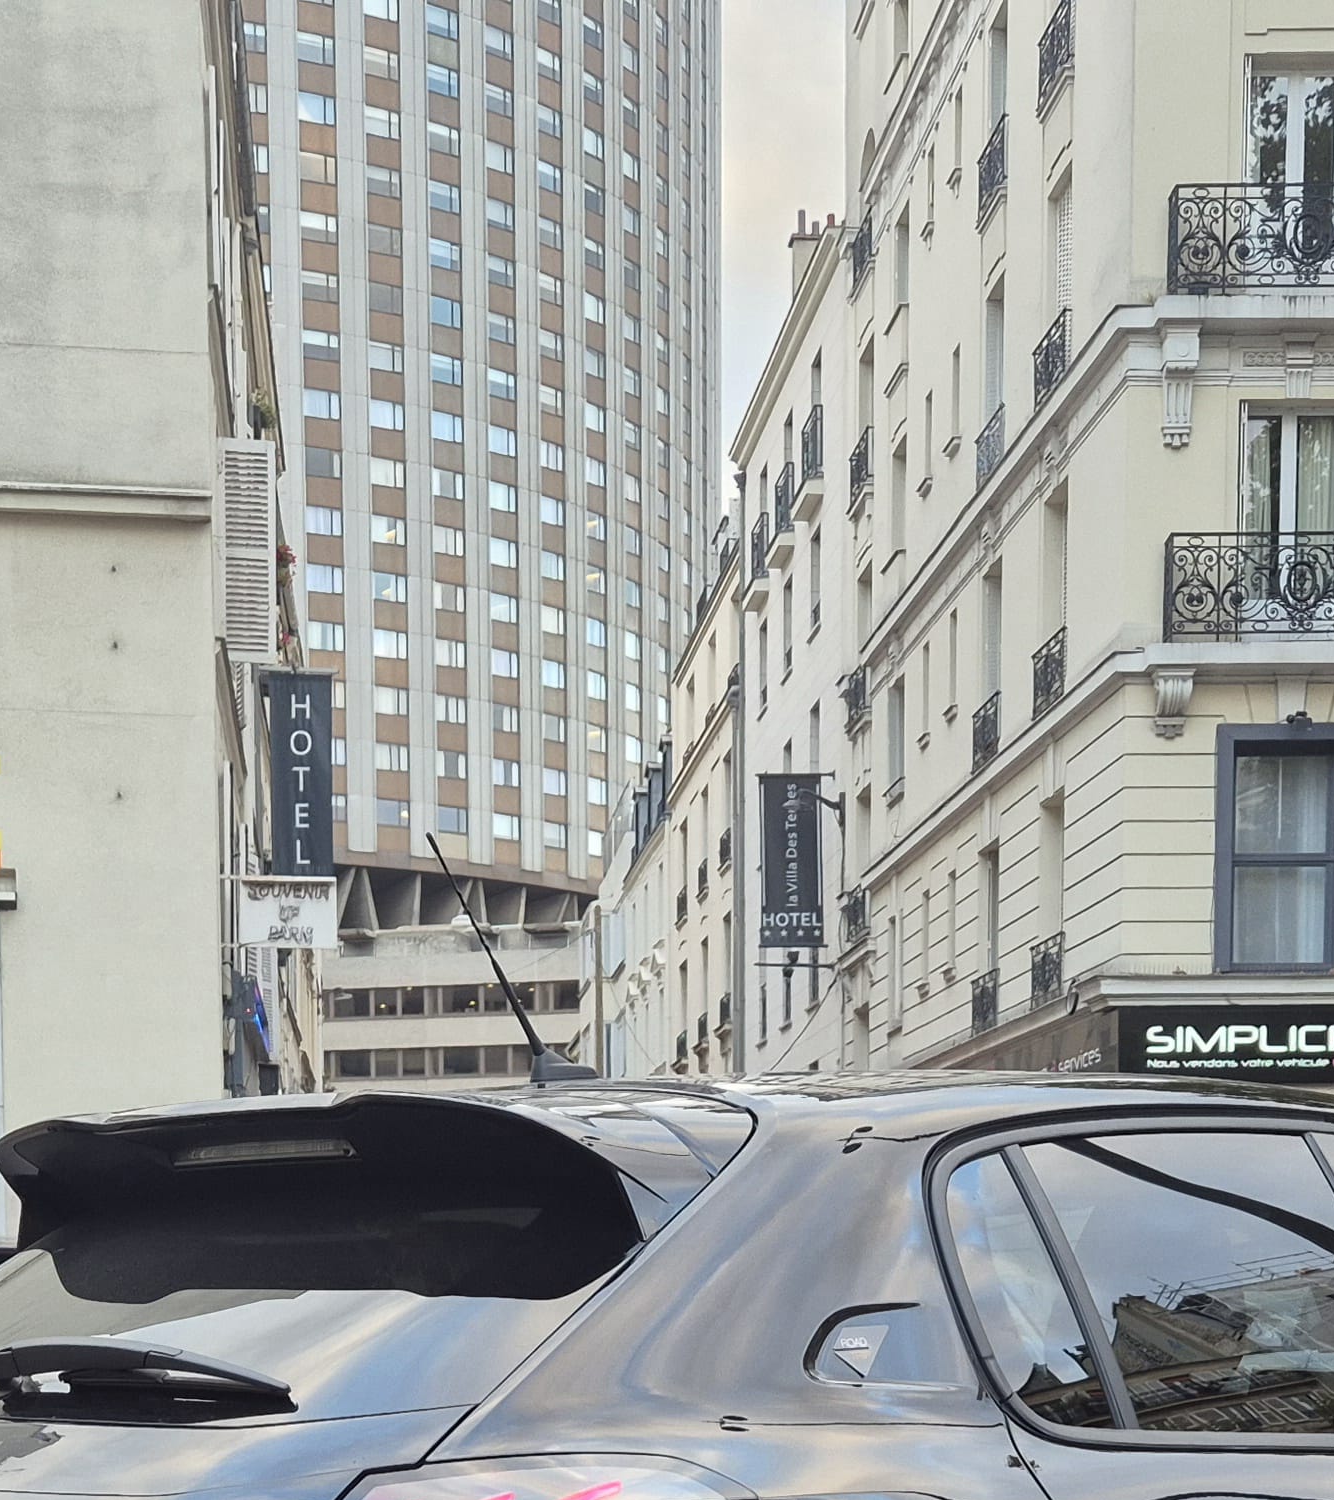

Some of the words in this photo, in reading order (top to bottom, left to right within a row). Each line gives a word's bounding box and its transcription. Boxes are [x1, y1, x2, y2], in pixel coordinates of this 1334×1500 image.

[289, 693, 313, 865] HOTEL
[785, 830, 798, 859] Des
[785, 861, 798, 895] Villa
[785, 895, 798, 907] la
[762, 911, 822, 927] HOTEL
[1058, 1047, 1101, 1073] services
[1147, 1059, 1180, 1068] Nous
[1182, 1059, 1238, 1068] vendons
[1241, 1058, 1274, 1067] votre
